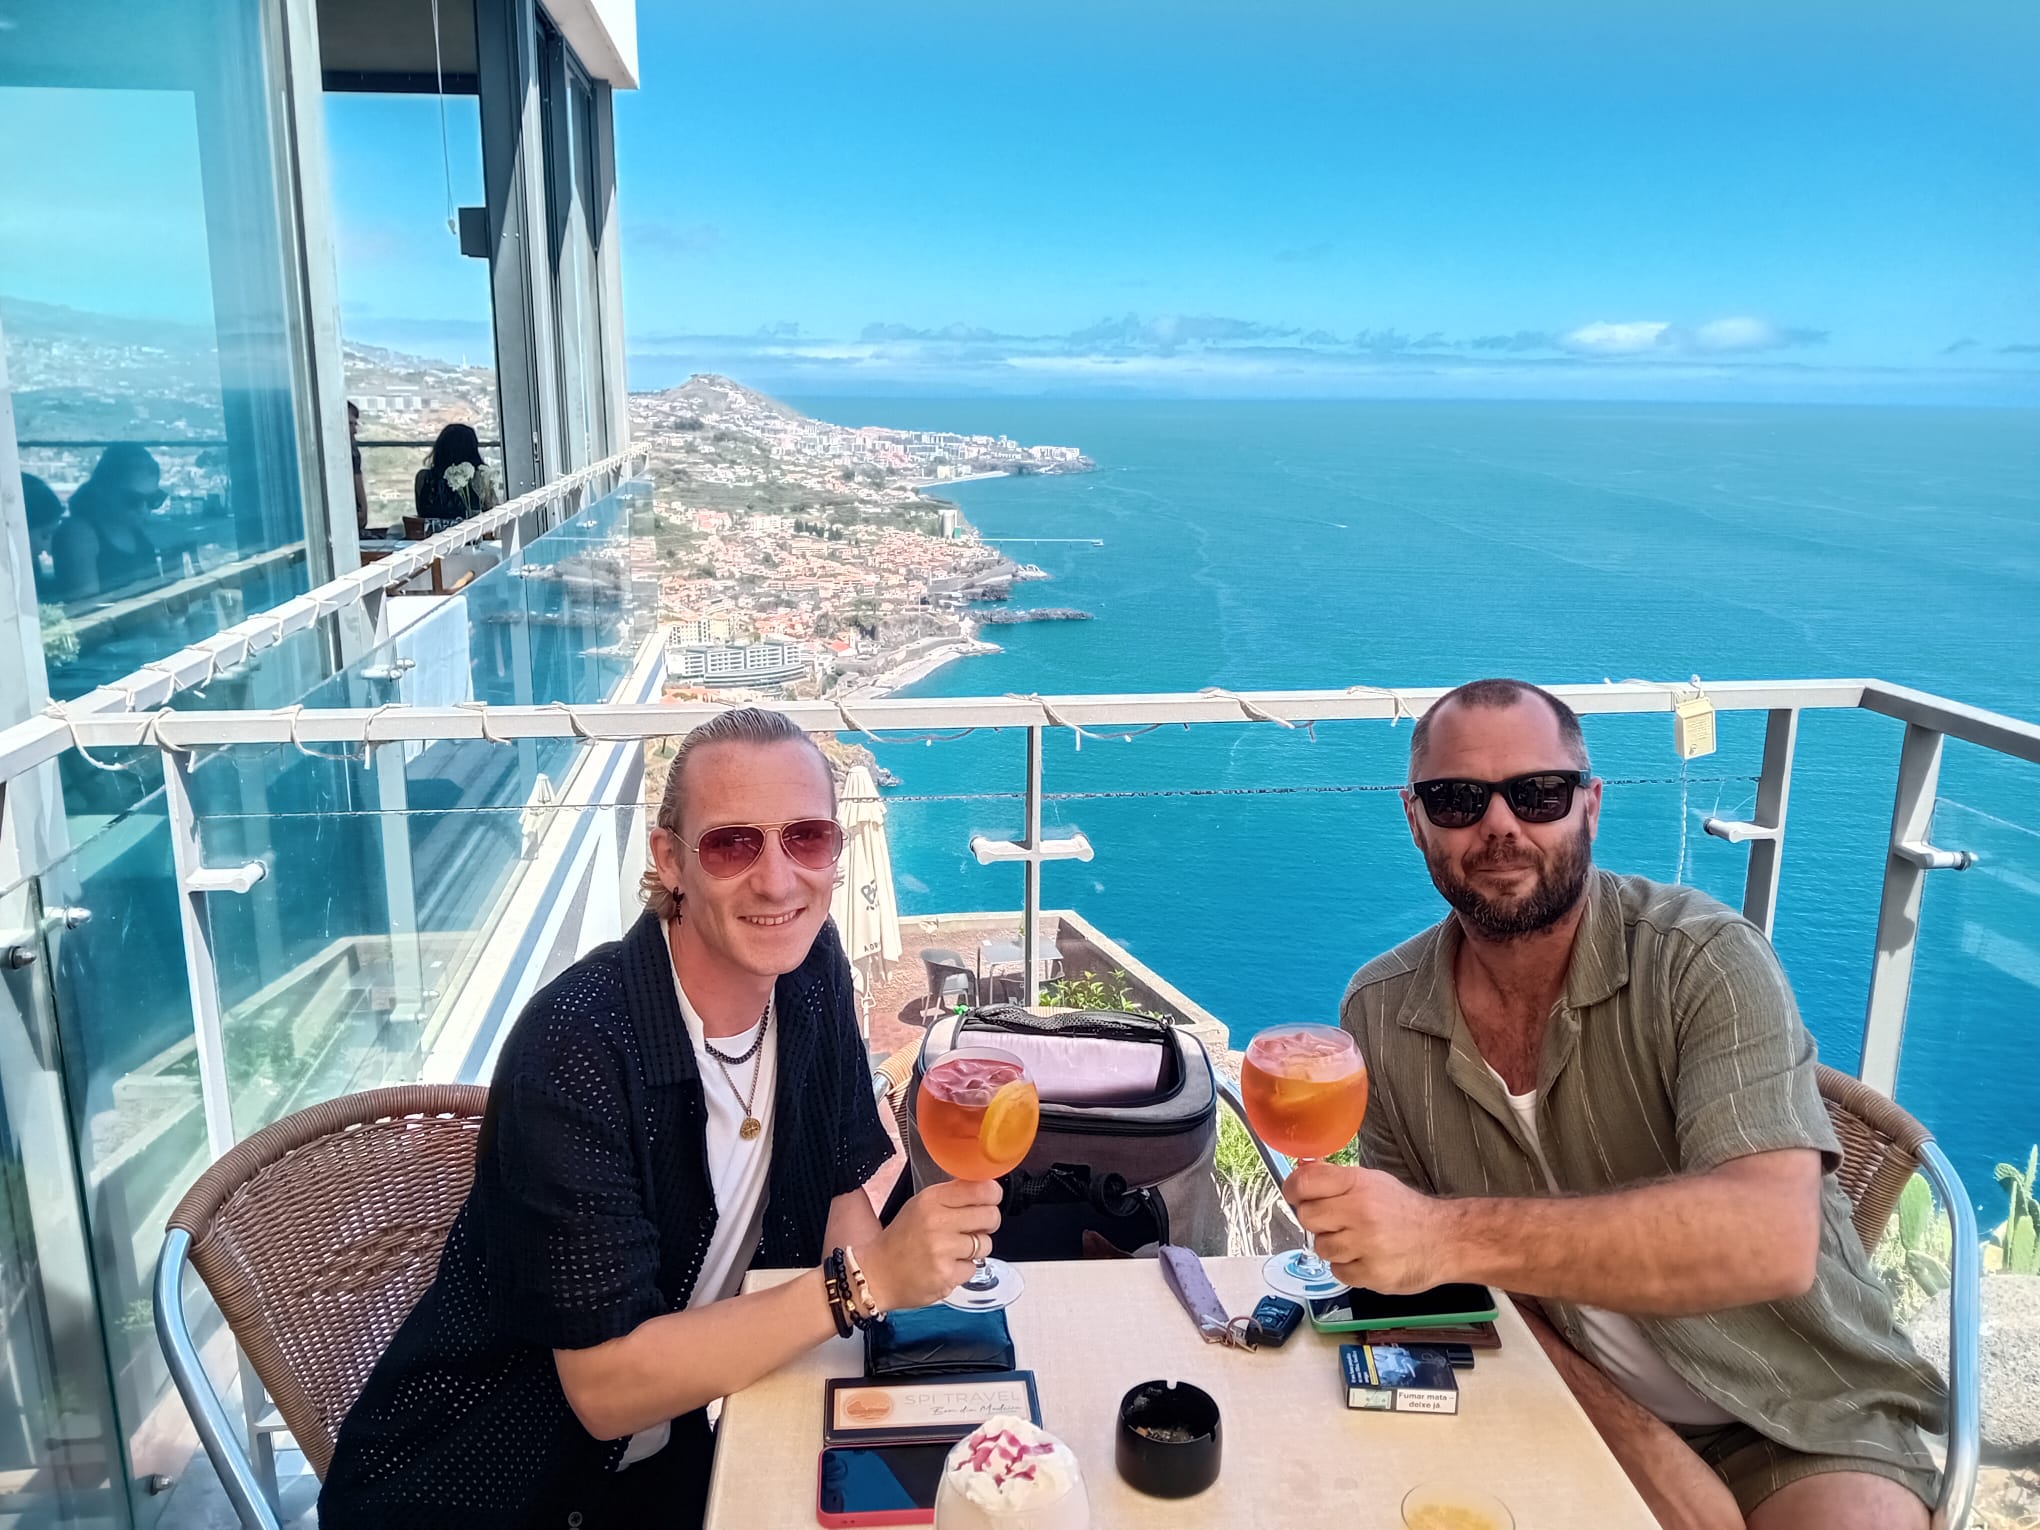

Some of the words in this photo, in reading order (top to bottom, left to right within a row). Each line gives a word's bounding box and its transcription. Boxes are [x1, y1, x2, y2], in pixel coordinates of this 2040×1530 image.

[904, 1394, 936, 1406] SPI
[944, 1390, 1019, 1404] TRAVEL
[1398, 1391, 1425, 1400] Fumar
